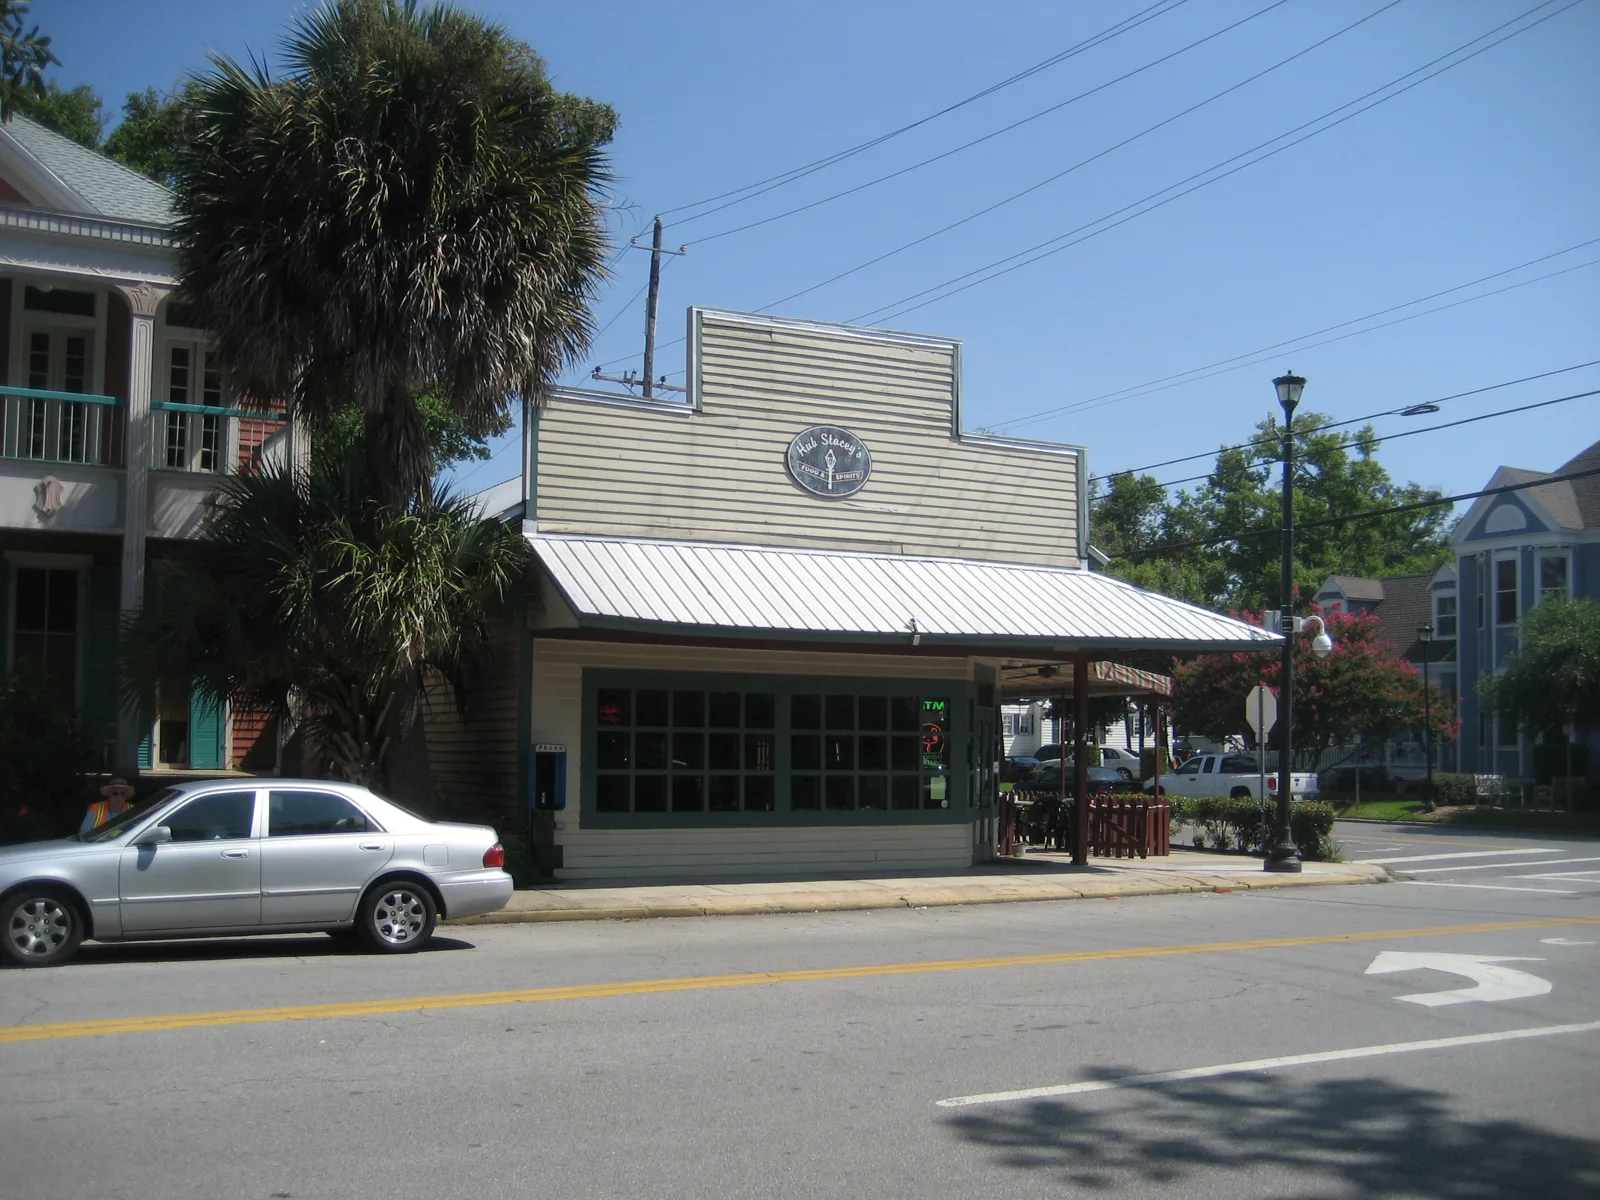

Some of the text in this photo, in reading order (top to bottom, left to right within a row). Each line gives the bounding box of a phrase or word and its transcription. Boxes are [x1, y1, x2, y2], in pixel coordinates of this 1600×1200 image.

[796, 433, 862, 458] Hub Stacey's
[801, 464, 819, 476] FOOD
[835, 472, 860, 480] SPIRITS
